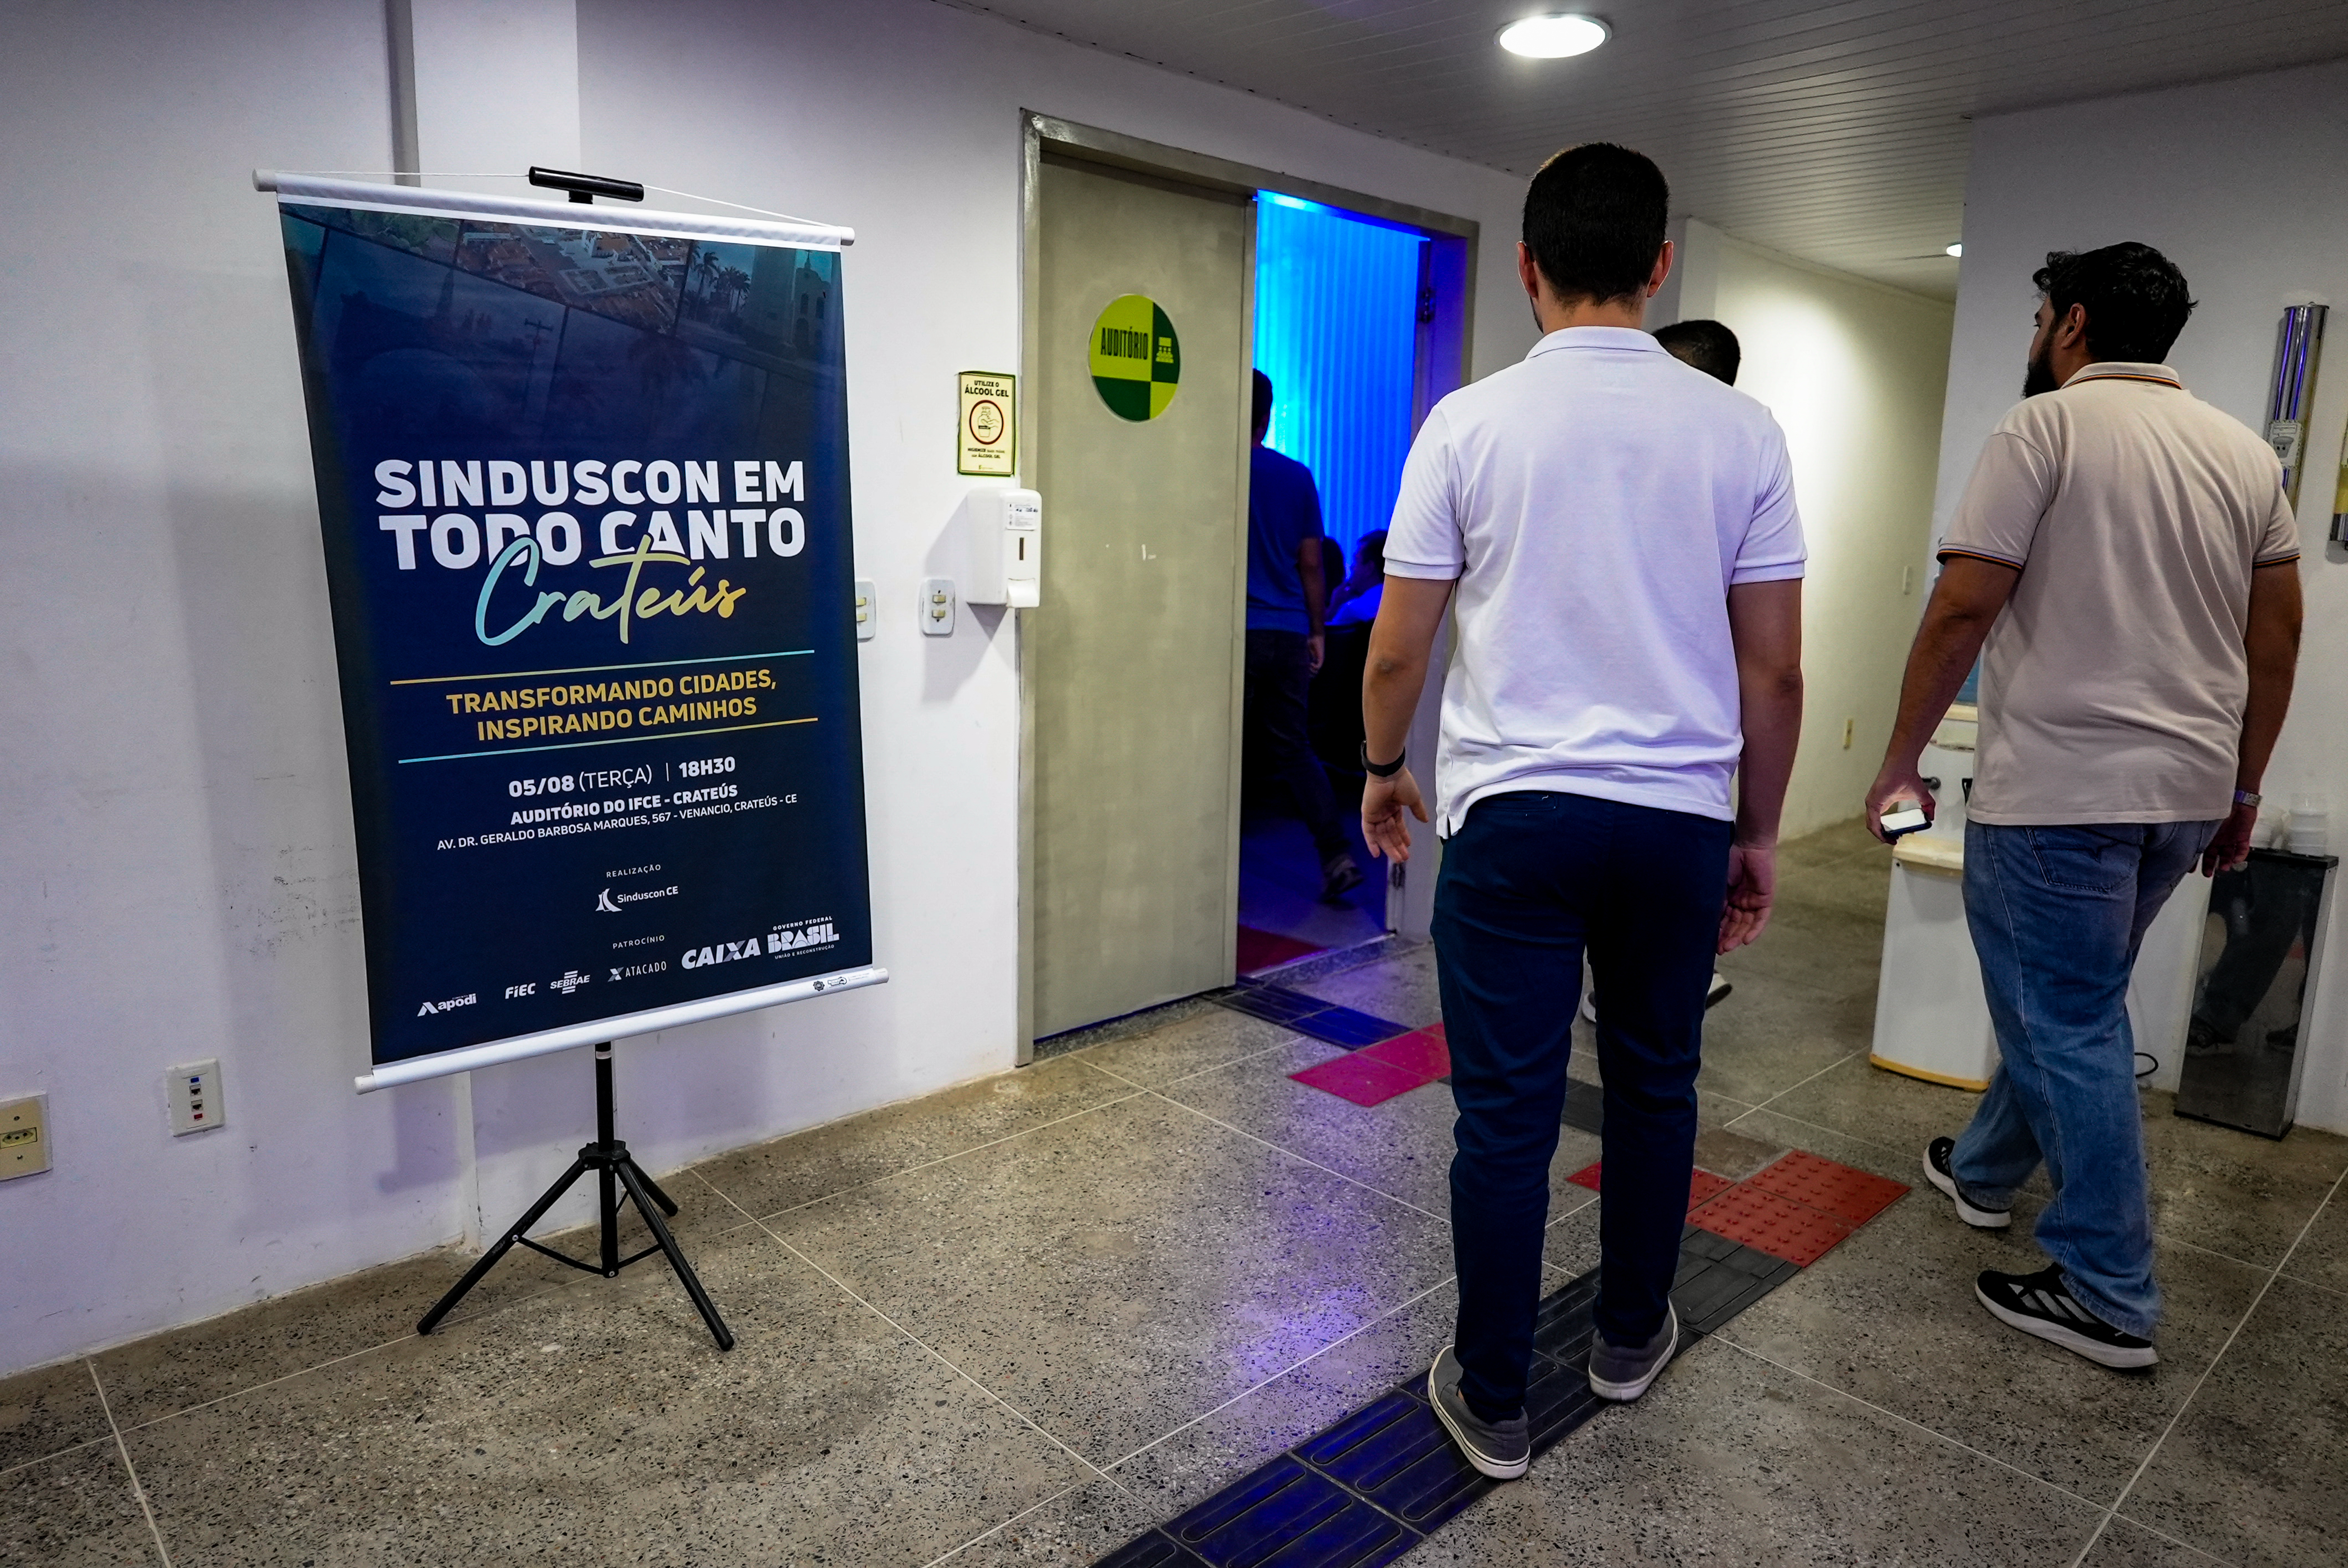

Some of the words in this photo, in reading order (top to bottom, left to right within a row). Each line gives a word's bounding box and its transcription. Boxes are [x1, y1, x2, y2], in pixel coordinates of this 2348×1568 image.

[1100, 326, 1148, 360] AUDITÓRIO
[965, 384, 994, 396] ÁLCOOL
[375, 460, 719, 507] SINDUSCON
[734, 461, 804, 502] EM
[379, 512, 581, 570] TODO
[600, 507, 805, 560] CANTO
[475, 534, 746, 646] Crateús
[446, 677, 673, 714] TRANSFORMANDO
[680, 669, 776, 694] CIDADES,
[477, 707, 633, 741] INSPIRANDO
[639, 697, 757, 725] CAMINHOS
[509, 775, 574, 797] 05/08
[579, 765, 652, 792] (TERÇA)
[679, 757, 735, 778] 18H30
[511, 802, 600, 825] AUDITÓRIO
[603, 799, 625, 814] DO
[628, 795, 661, 811] IFCE
[673, 783, 738, 805] CRATEÚS
[437, 839, 456, 850] AV.
[458, 837, 478, 847] DR.
[480, 830, 535, 845] GERALDO
[538, 822, 592, 838] BARBOSA
[594, 815, 650, 830] MARQUES,
[652, 812, 671, 823] 567
[679, 804, 733, 819] VENANCIO,
[734, 795, 778, 811] CRATEÚS
[786, 794, 797, 803] CE
[607, 864, 661, 878] REALIZAÇÃO
[618, 890, 665, 903] Sinduscon
[666, 886, 679, 895] CE
[767, 922, 840, 953] BRASIL
[773, 921, 803, 930] GOVERNO
[805, 916, 833, 925] FEDERAL
[613, 935, 664, 949] PATROCÍNIO
[681, 938, 761, 969] CAIXA
[797, 944, 834, 955] RECONSTRUÇÃO
[550, 975, 590, 989] SEBRAE
[626, 961, 666, 977] ATACADO
[438, 993, 477, 1011] apodi
